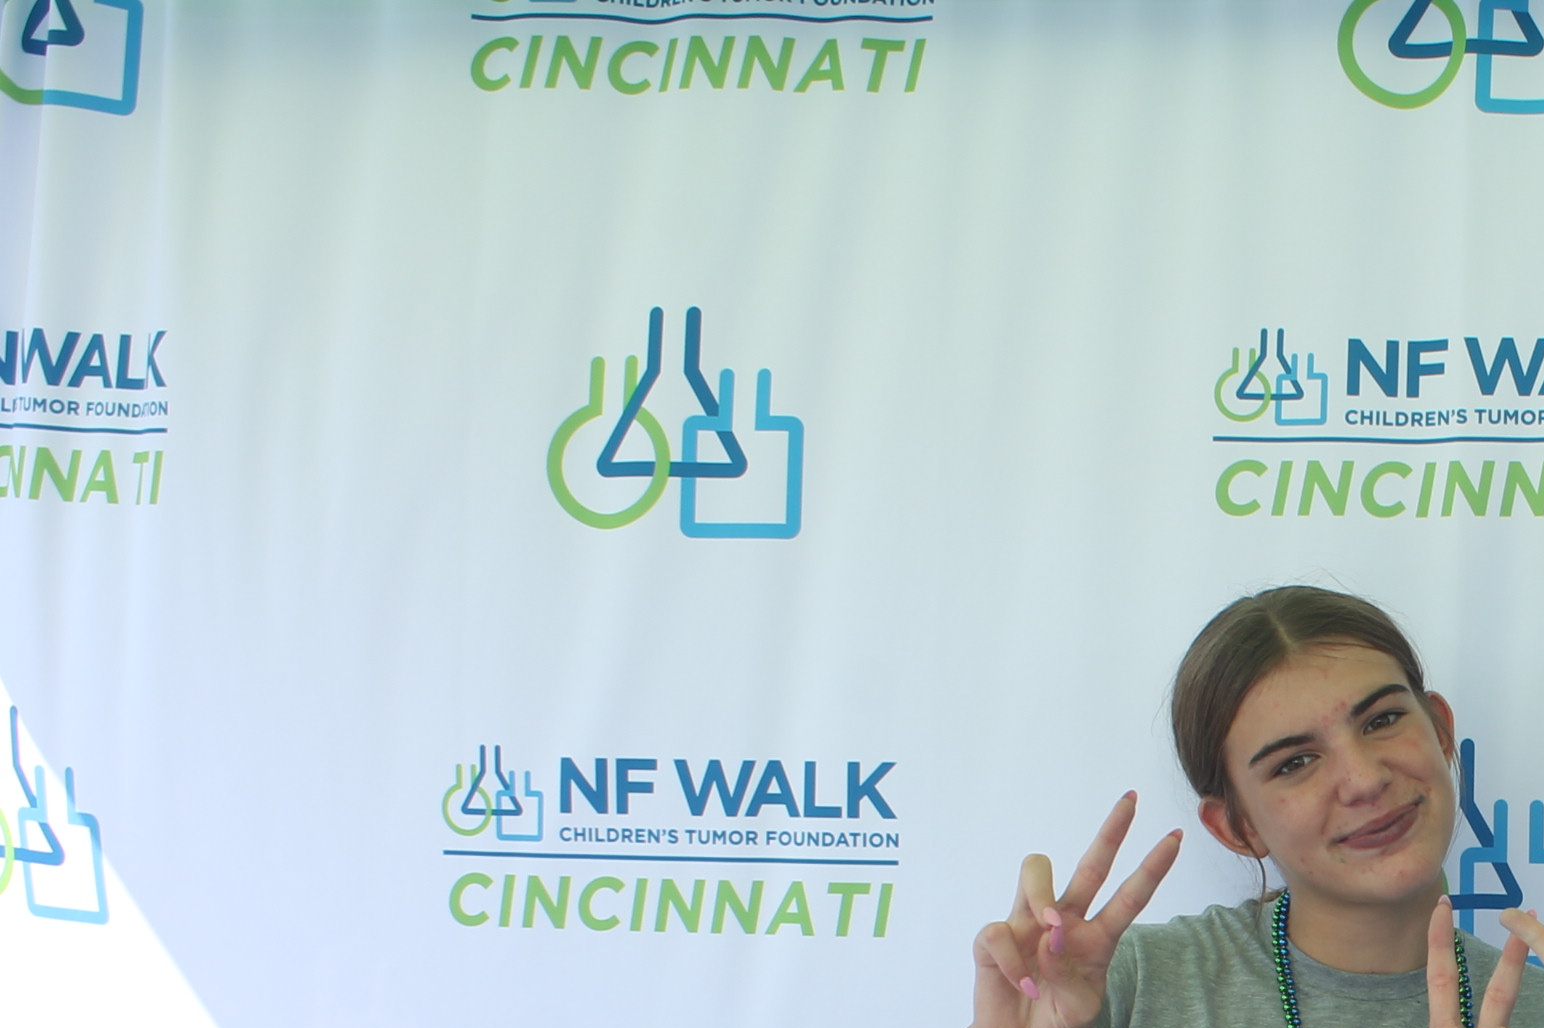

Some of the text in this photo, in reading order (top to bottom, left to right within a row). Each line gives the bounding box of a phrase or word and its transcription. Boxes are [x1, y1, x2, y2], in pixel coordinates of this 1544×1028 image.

[470, 35, 927, 95] CINCINNATI
[21, 327, 168, 390] WALK
[1346, 337, 1449, 398] NF
[1345, 408, 1468, 427] CHILDREN'S
[559, 757, 898, 819] NF WALK
[559, 826, 900, 849] CHILDREN'S TUMOR FOUNDATION
[449, 872, 894, 938] CINCINNATI
